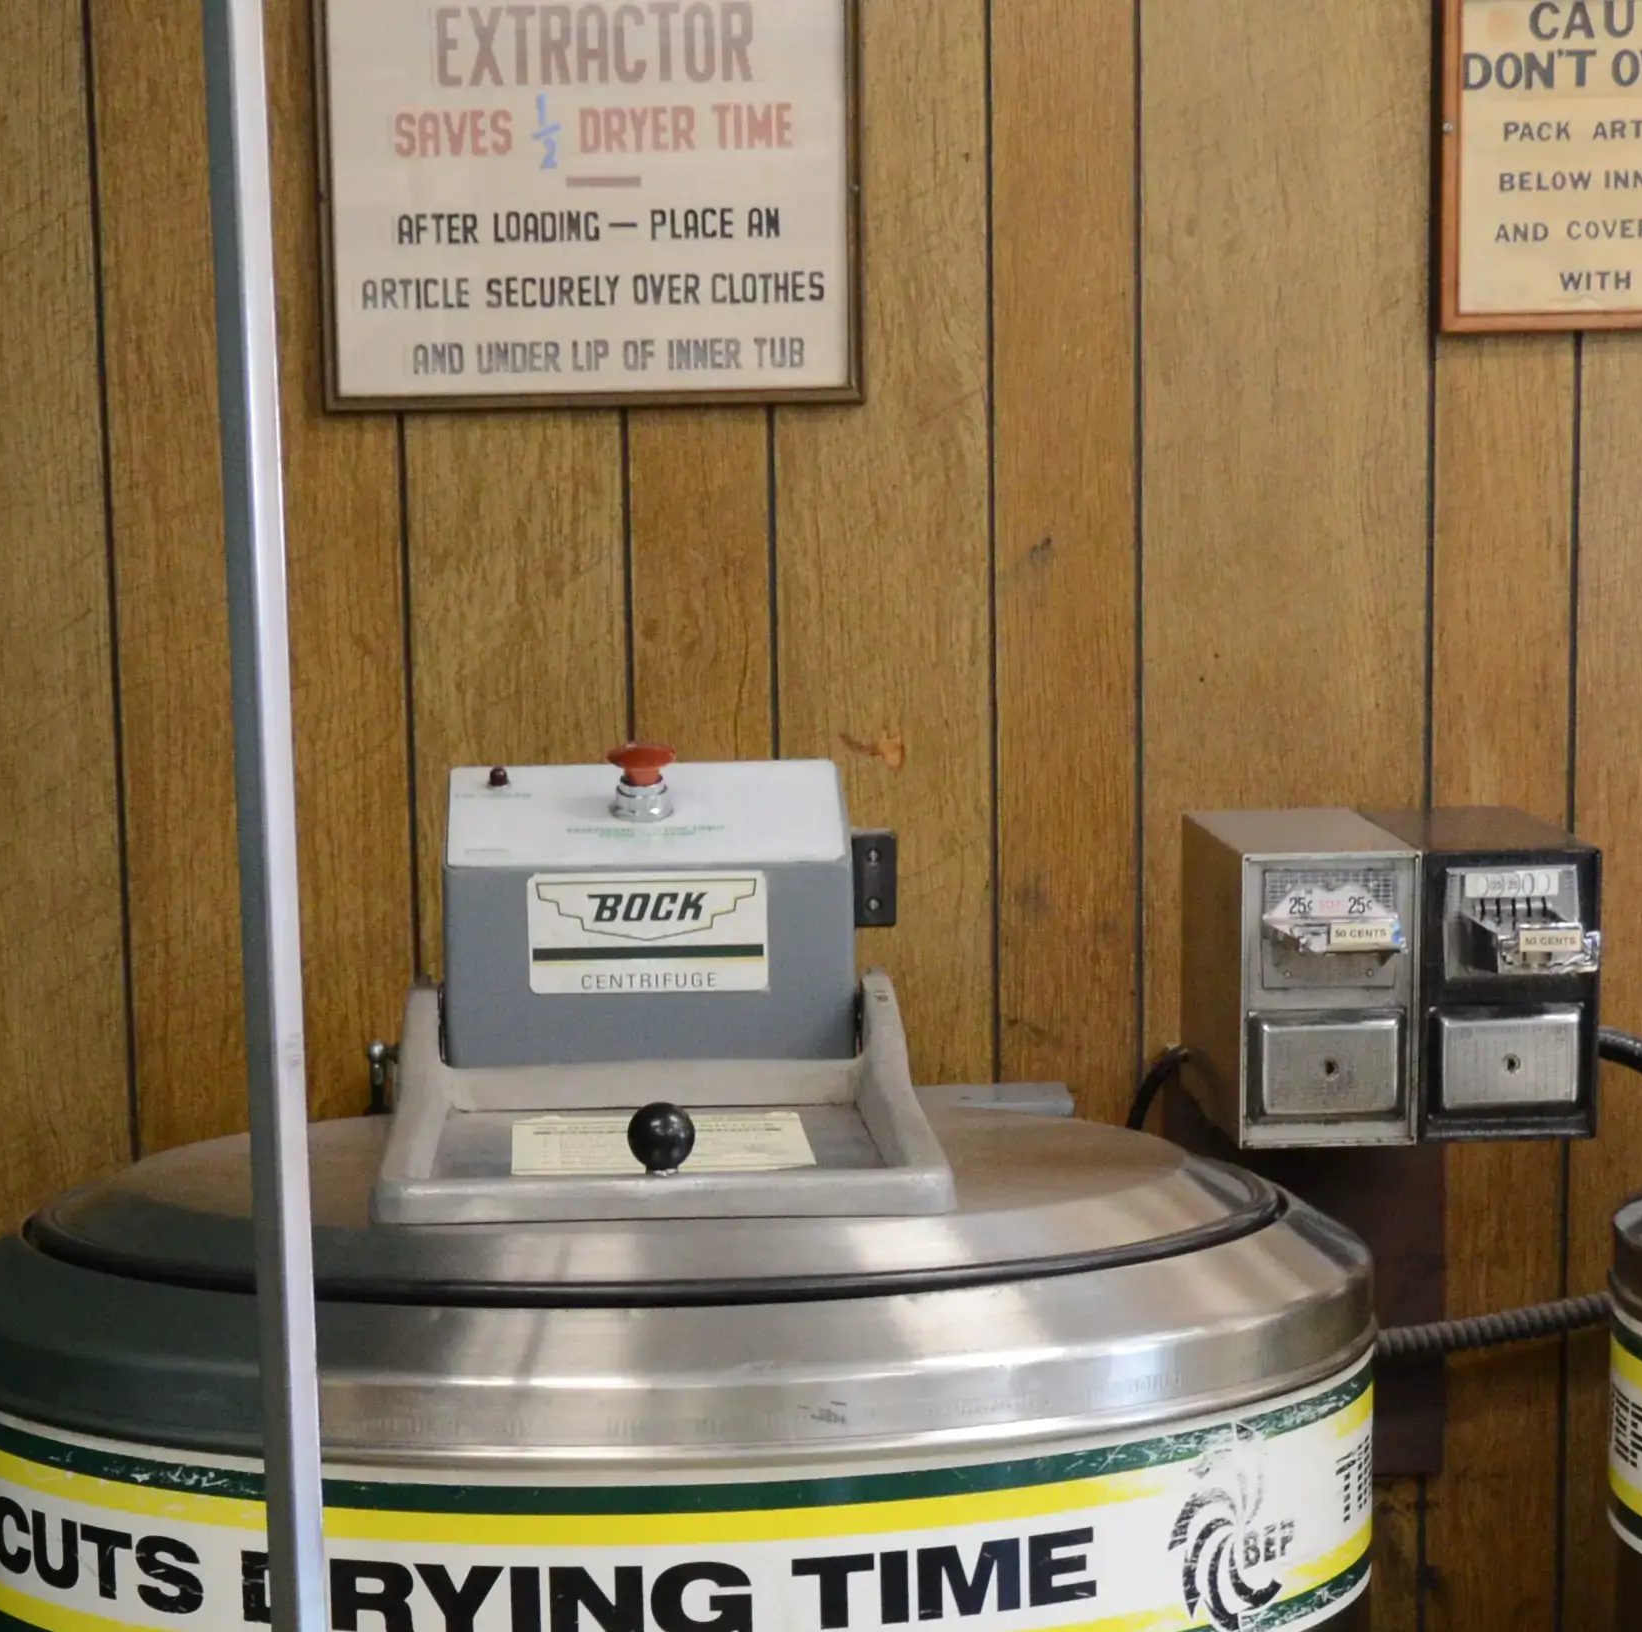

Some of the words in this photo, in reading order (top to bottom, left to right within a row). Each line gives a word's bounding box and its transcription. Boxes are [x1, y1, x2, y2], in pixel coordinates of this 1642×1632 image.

[436, 3, 752, 88] EXTRACTOR
[1463, 49, 1596, 92] DON'T
[395, 110, 512, 158] SAVES
[579, 106, 695, 154] DRYER
[712, 102, 792, 149] TIME
[1504, 121, 1570, 142] PACK
[1499, 171, 1591, 192] BELOW
[398, 213, 478, 245] AFTER
[494, 211, 600, 243] LOADING
[651, 208, 733, 240] PLACE
[748, 208, 779, 238] AN
[1495, 223, 1548, 242] AND
[362, 278, 469, 310] ARTICLE
[486, 275, 619, 307] SECURELY
[633, 274, 700, 305] OVER
[712, 271, 824, 304] CLOTHES
[1559, 271, 1630, 291] WITH
[413, 343, 464, 374] AND
[477, 341, 561, 374] UNDER
[572, 339, 609, 372] LIP
[623, 339, 654, 370] OF
[668, 338, 742, 371] INNER
[754, 337, 804, 368] TUB
[588, 892, 708, 922] BOCK
[1335, 930, 1346, 938] 50
[1349, 928, 1387, 938] CENTS
[1525, 937, 1537, 945] 50
[1540, 936, 1576, 947] CENTS
[581, 973, 717, 990] CENTRIFUGE
[791, 1526, 1097, 1631] TIME
